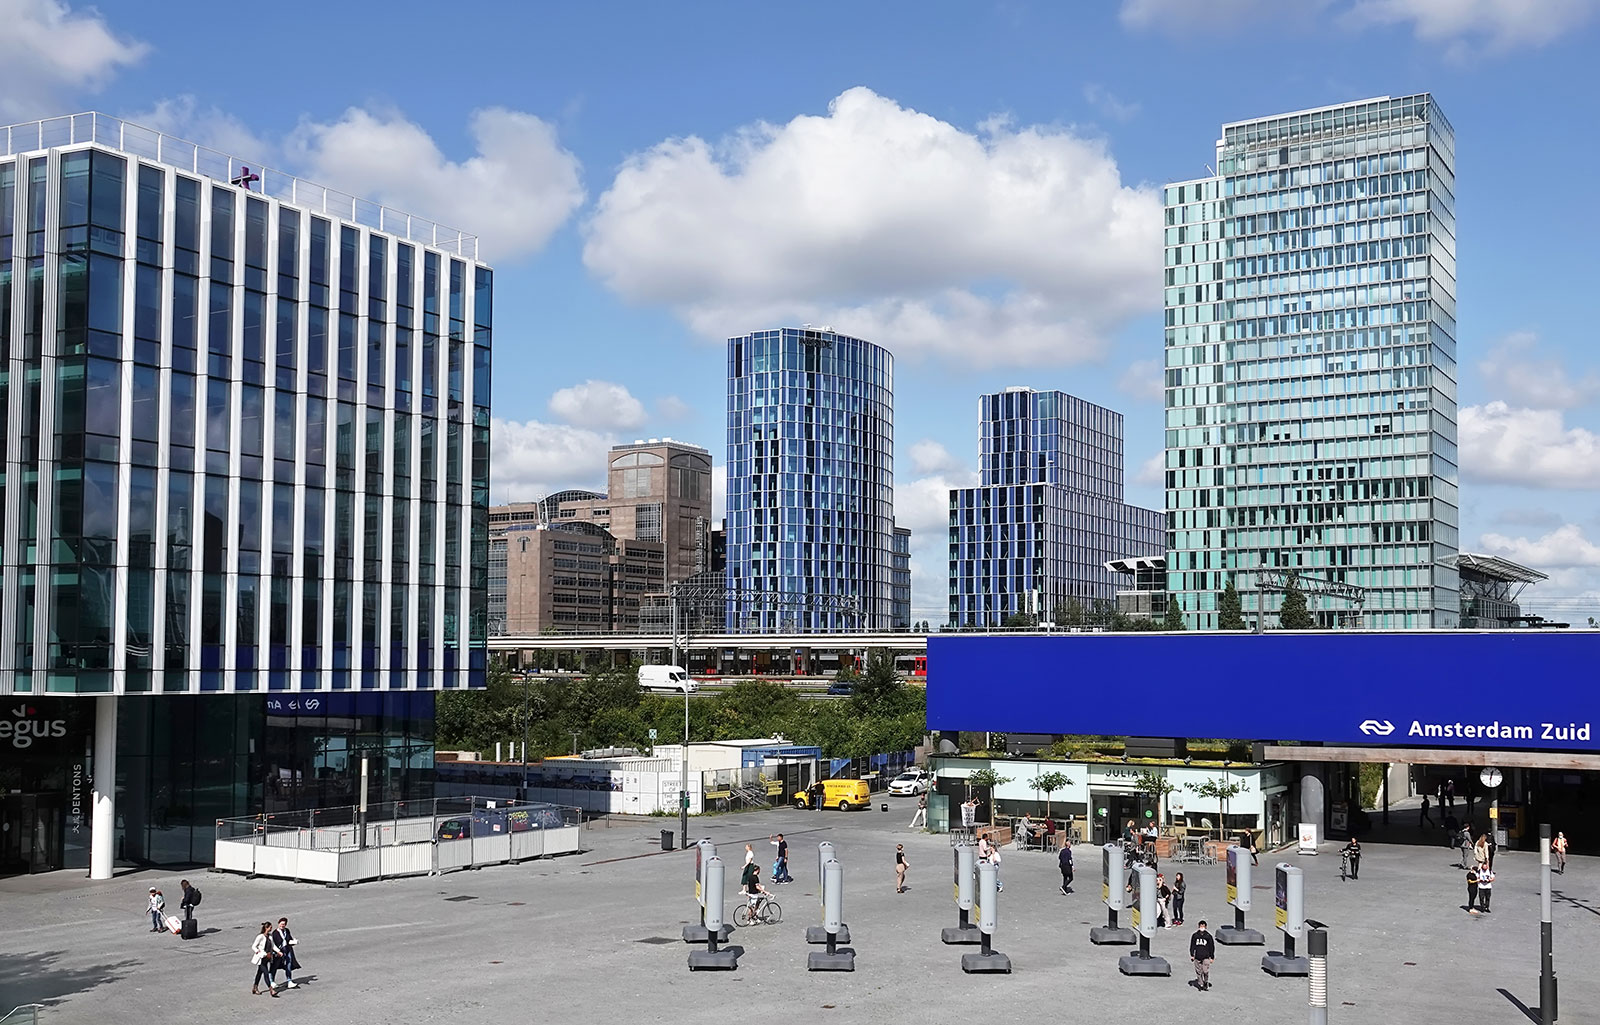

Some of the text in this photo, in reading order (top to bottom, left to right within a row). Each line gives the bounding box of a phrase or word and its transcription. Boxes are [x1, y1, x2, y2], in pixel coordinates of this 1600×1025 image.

[0, 719, 67, 749] egus
[1408, 720, 1591, 741] Amsterdam Zuid
[72, 763, 82, 815] DENTONS
